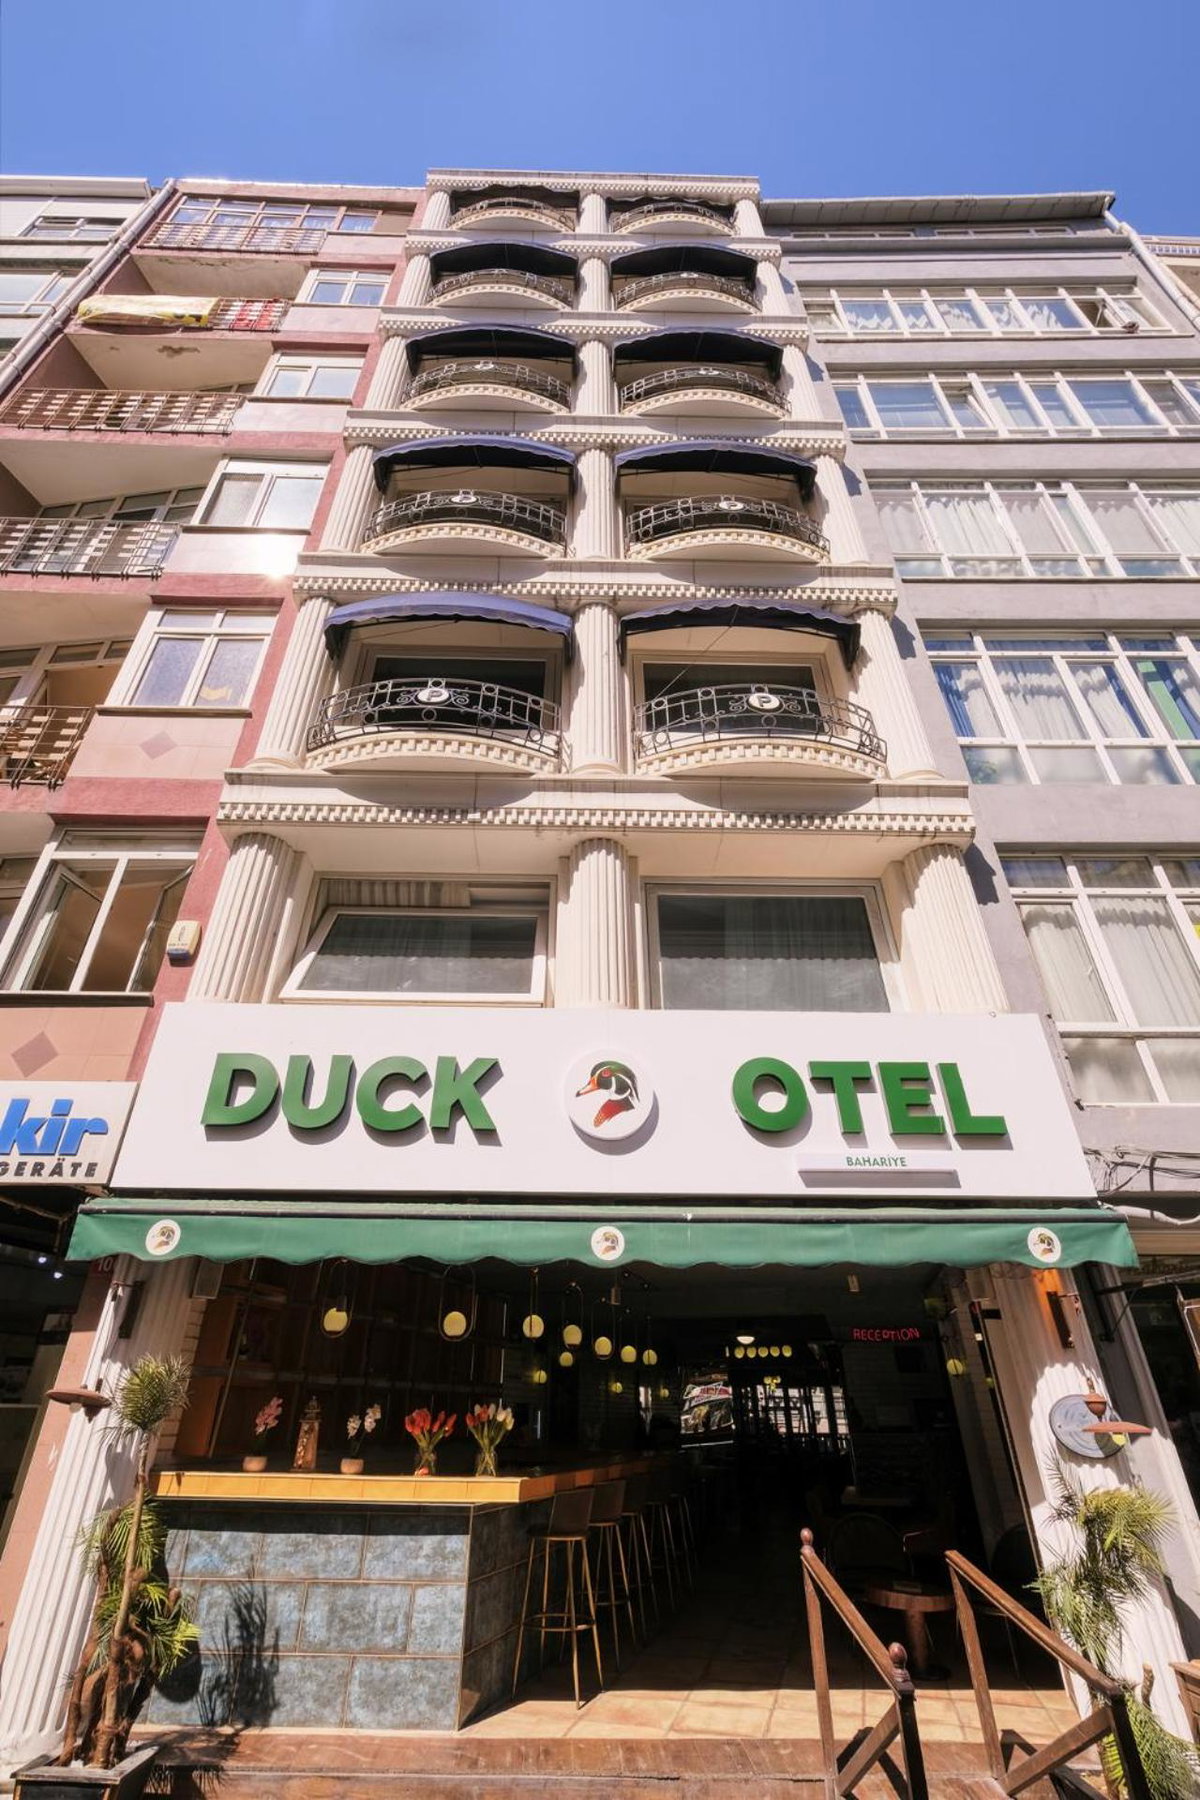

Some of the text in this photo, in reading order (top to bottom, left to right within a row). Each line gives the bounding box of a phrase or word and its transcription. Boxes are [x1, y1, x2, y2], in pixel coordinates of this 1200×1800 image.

[427, 690, 443, 701] P
[757, 695, 772, 707] P
[201, 1053, 1009, 1136] DUCK OTEL
[852, 1327, 920, 1341] RECEPTION
